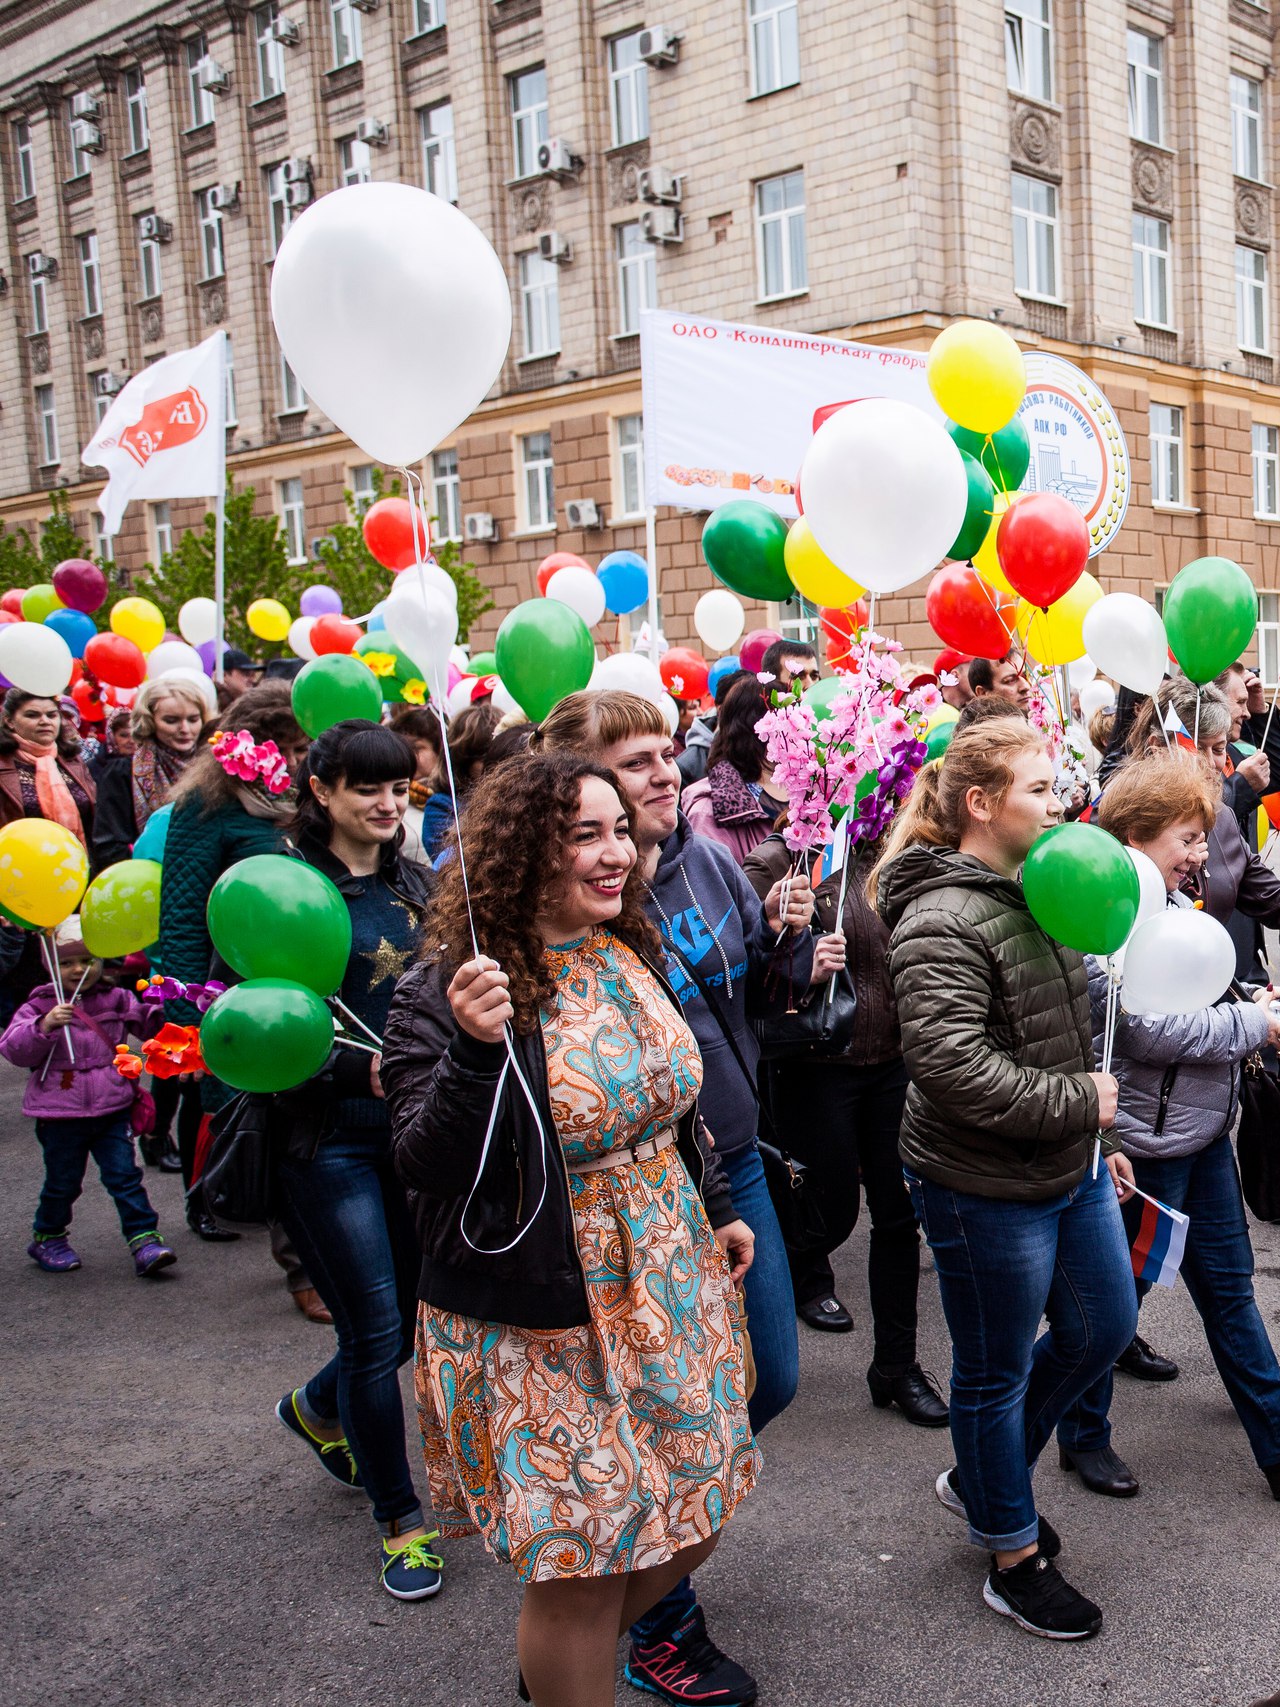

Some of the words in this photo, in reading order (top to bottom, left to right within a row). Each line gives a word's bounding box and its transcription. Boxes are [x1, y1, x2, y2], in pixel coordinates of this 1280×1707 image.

[672, 322, 718, 339] ОАО
[1049, 394, 1095, 439] РАБОТНИКОВ
[1034, 419, 1050, 434] АПК
[1054, 422, 1068, 436] РФ
